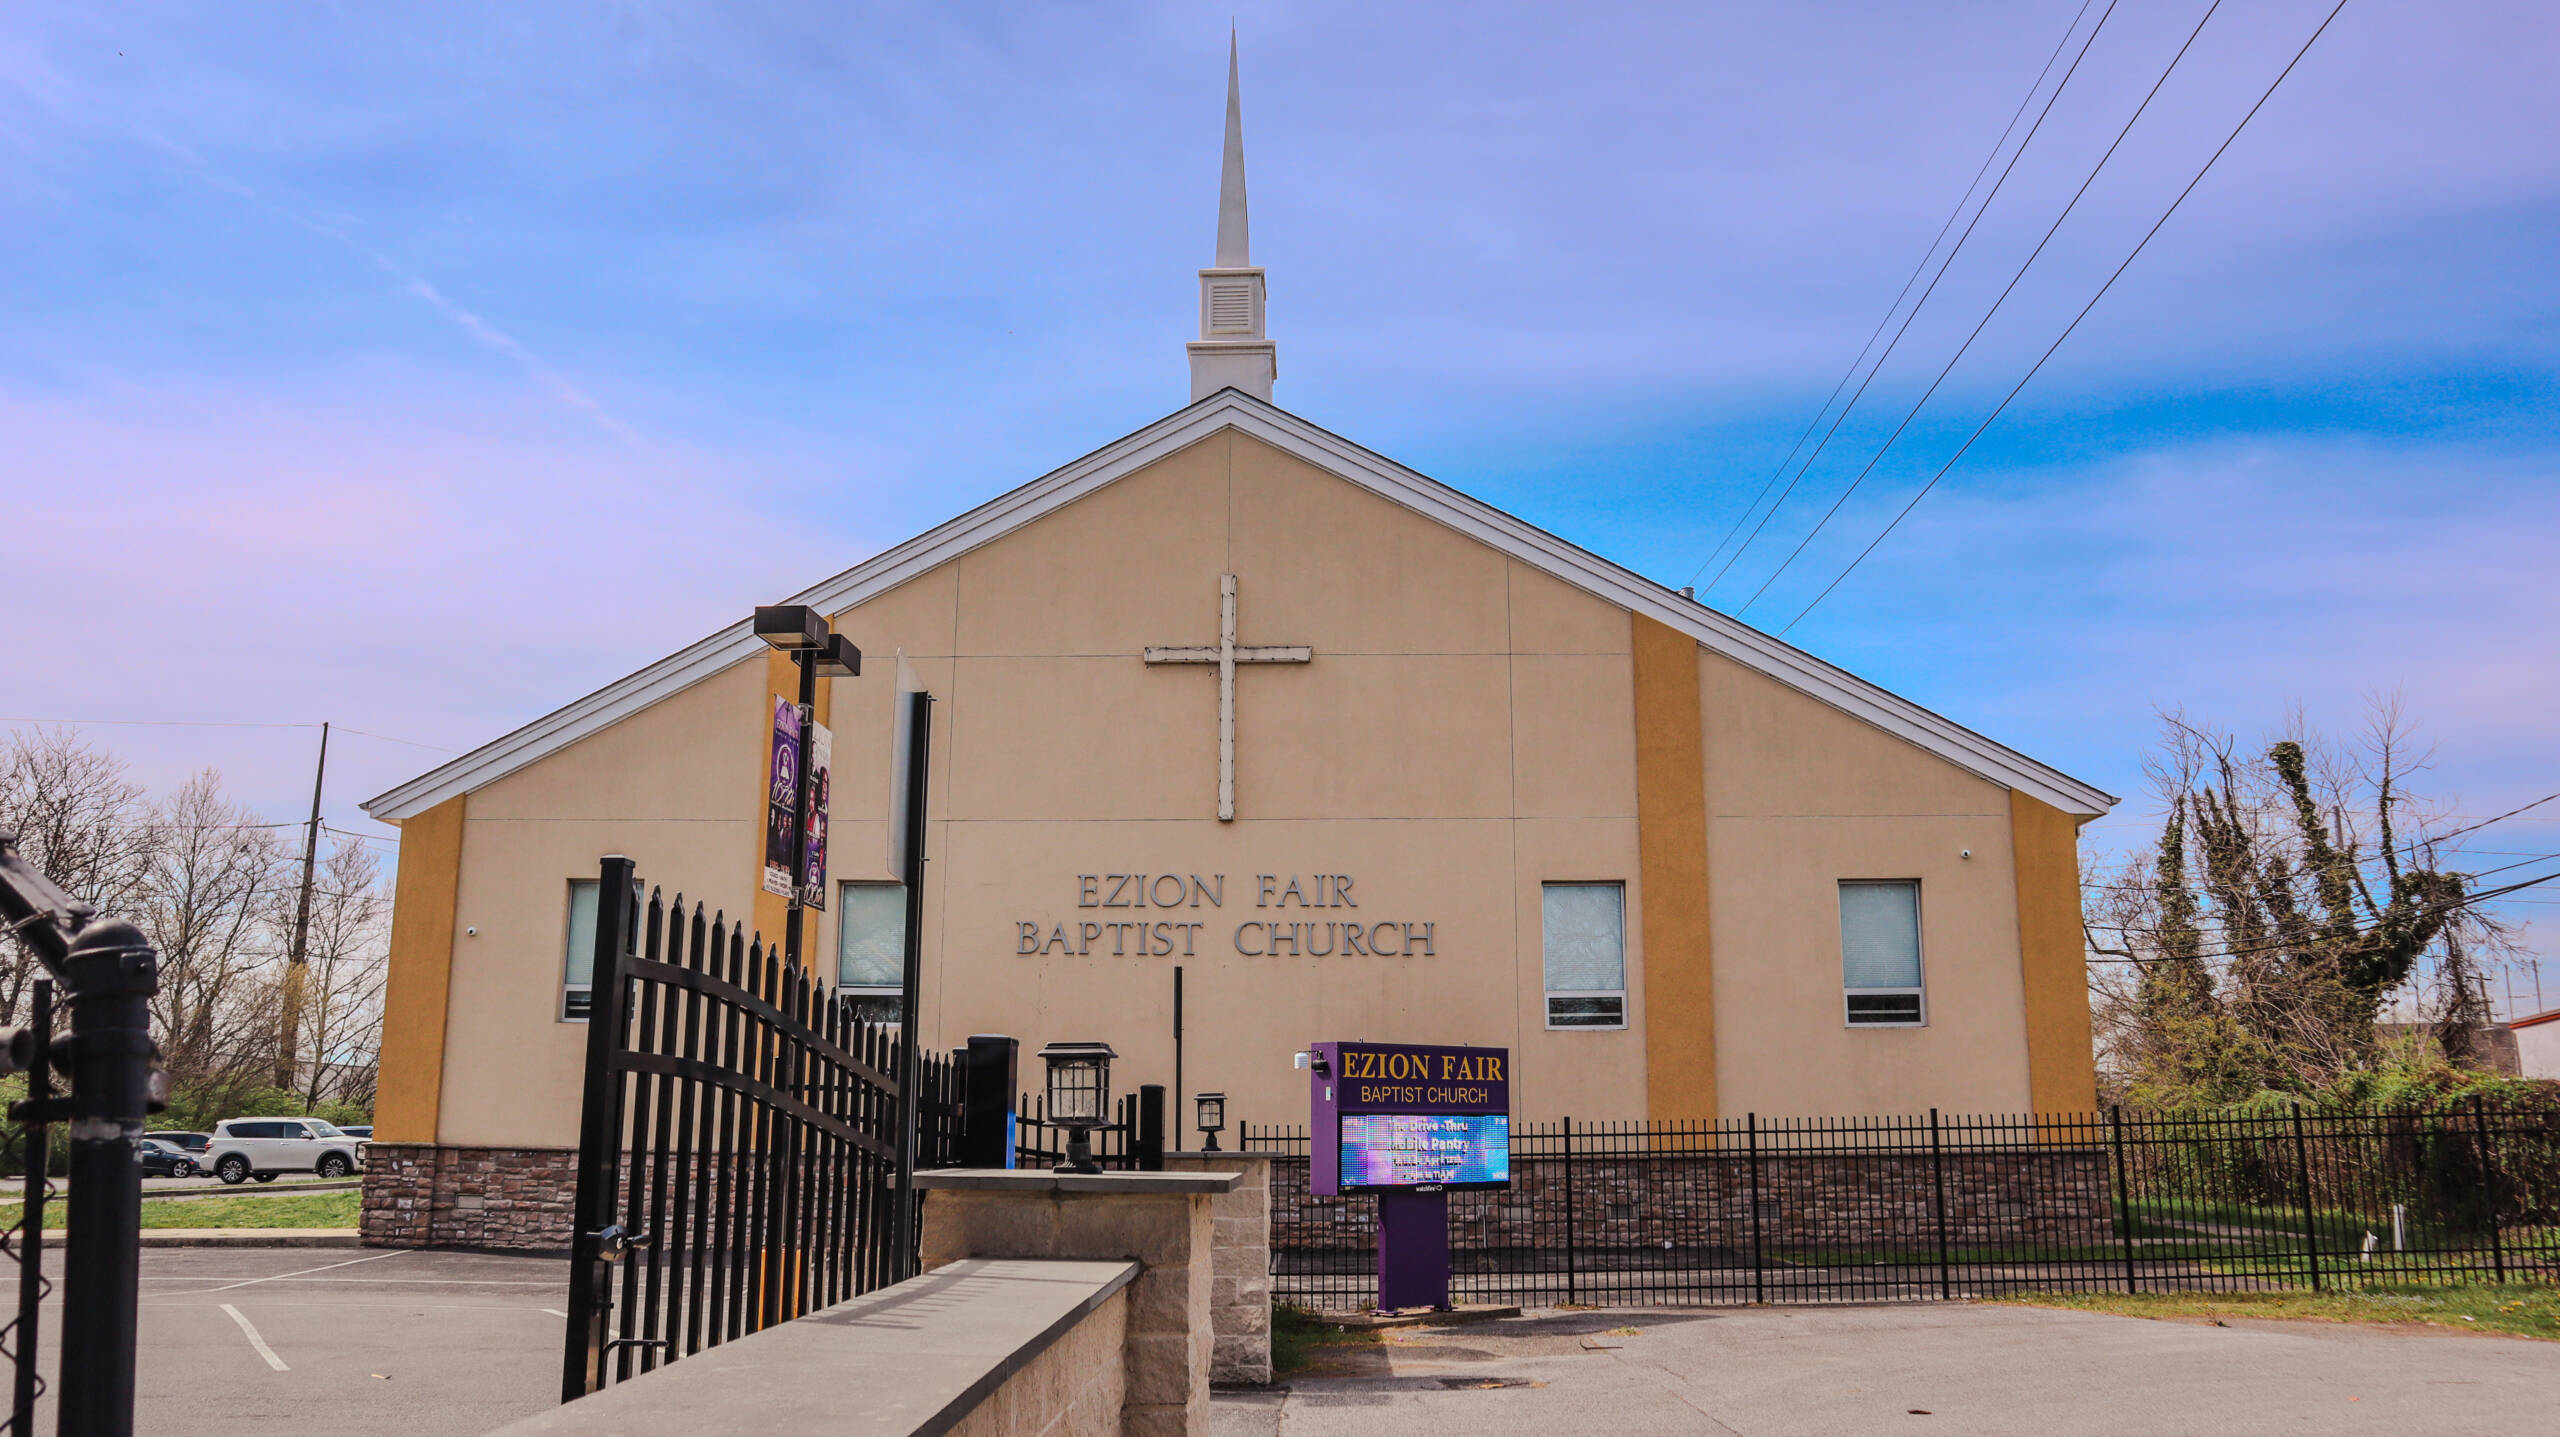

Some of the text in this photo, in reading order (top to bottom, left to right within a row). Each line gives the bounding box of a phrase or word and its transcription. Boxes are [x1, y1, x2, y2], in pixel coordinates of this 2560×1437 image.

[1077, 873, 1359, 908] EZION FAIR
[1016, 920, 1436, 956] BAPTIST CHURCH
[1342, 1052, 1504, 1081] EZION FAIR
[1361, 1086, 1488, 1104] BAPTIST CHURCH
[1409, 1118, 1439, 1132] Drive
[1431, 1137, 1471, 1153] Pantry
